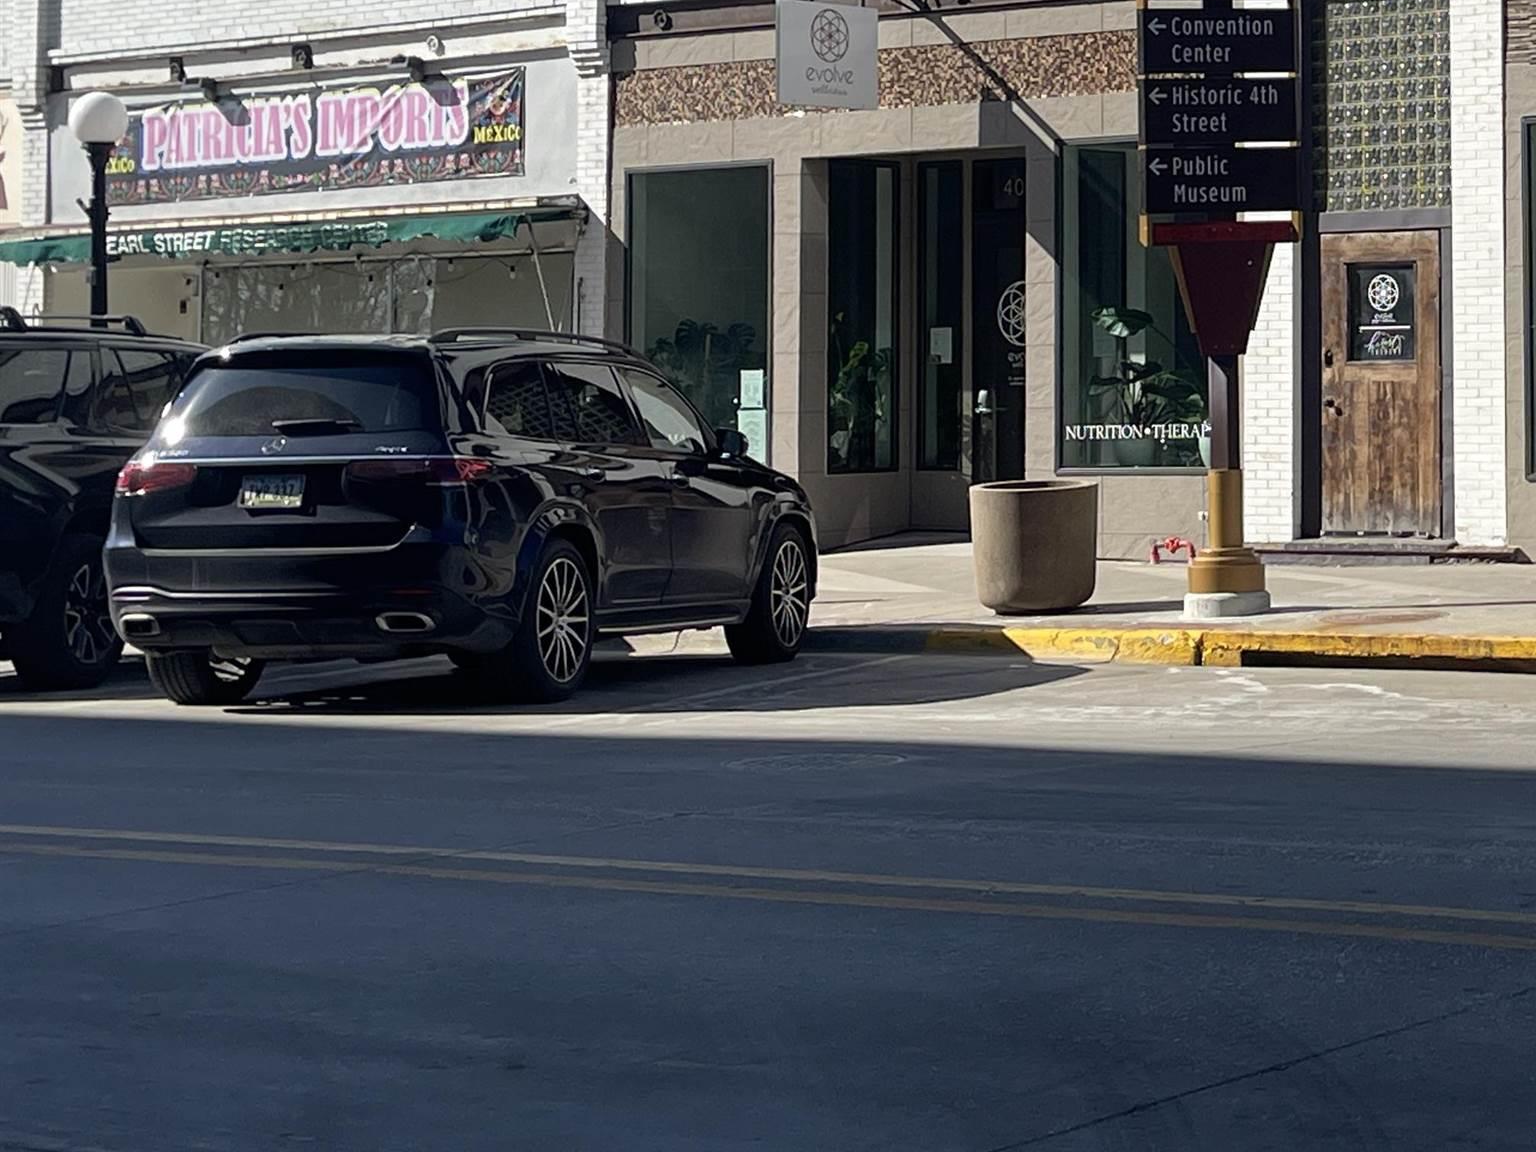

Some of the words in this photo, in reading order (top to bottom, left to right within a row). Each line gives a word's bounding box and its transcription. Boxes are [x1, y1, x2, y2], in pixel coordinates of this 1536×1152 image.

[1170, 16, 1274, 36] Convention
[1171, 44, 1231, 63] Center
[806, 64, 854, 84] evolve
[1172, 86, 1243, 105] Historic
[1249, 86, 1279, 105] 4th
[143, 97, 311, 169] PATRICIA'S
[317, 82, 468, 154] IMPORTS
[1172, 113, 1228, 133] Street
[1172, 156, 1229, 176] Public
[1174, 184, 1247, 203] Museum
[106, 232, 149, 255] EARL
[154, 231, 215, 252] STREET
[1065, 424, 1143, 440] NUTRITION
[1151, 423, 1211, 439] THERAP
